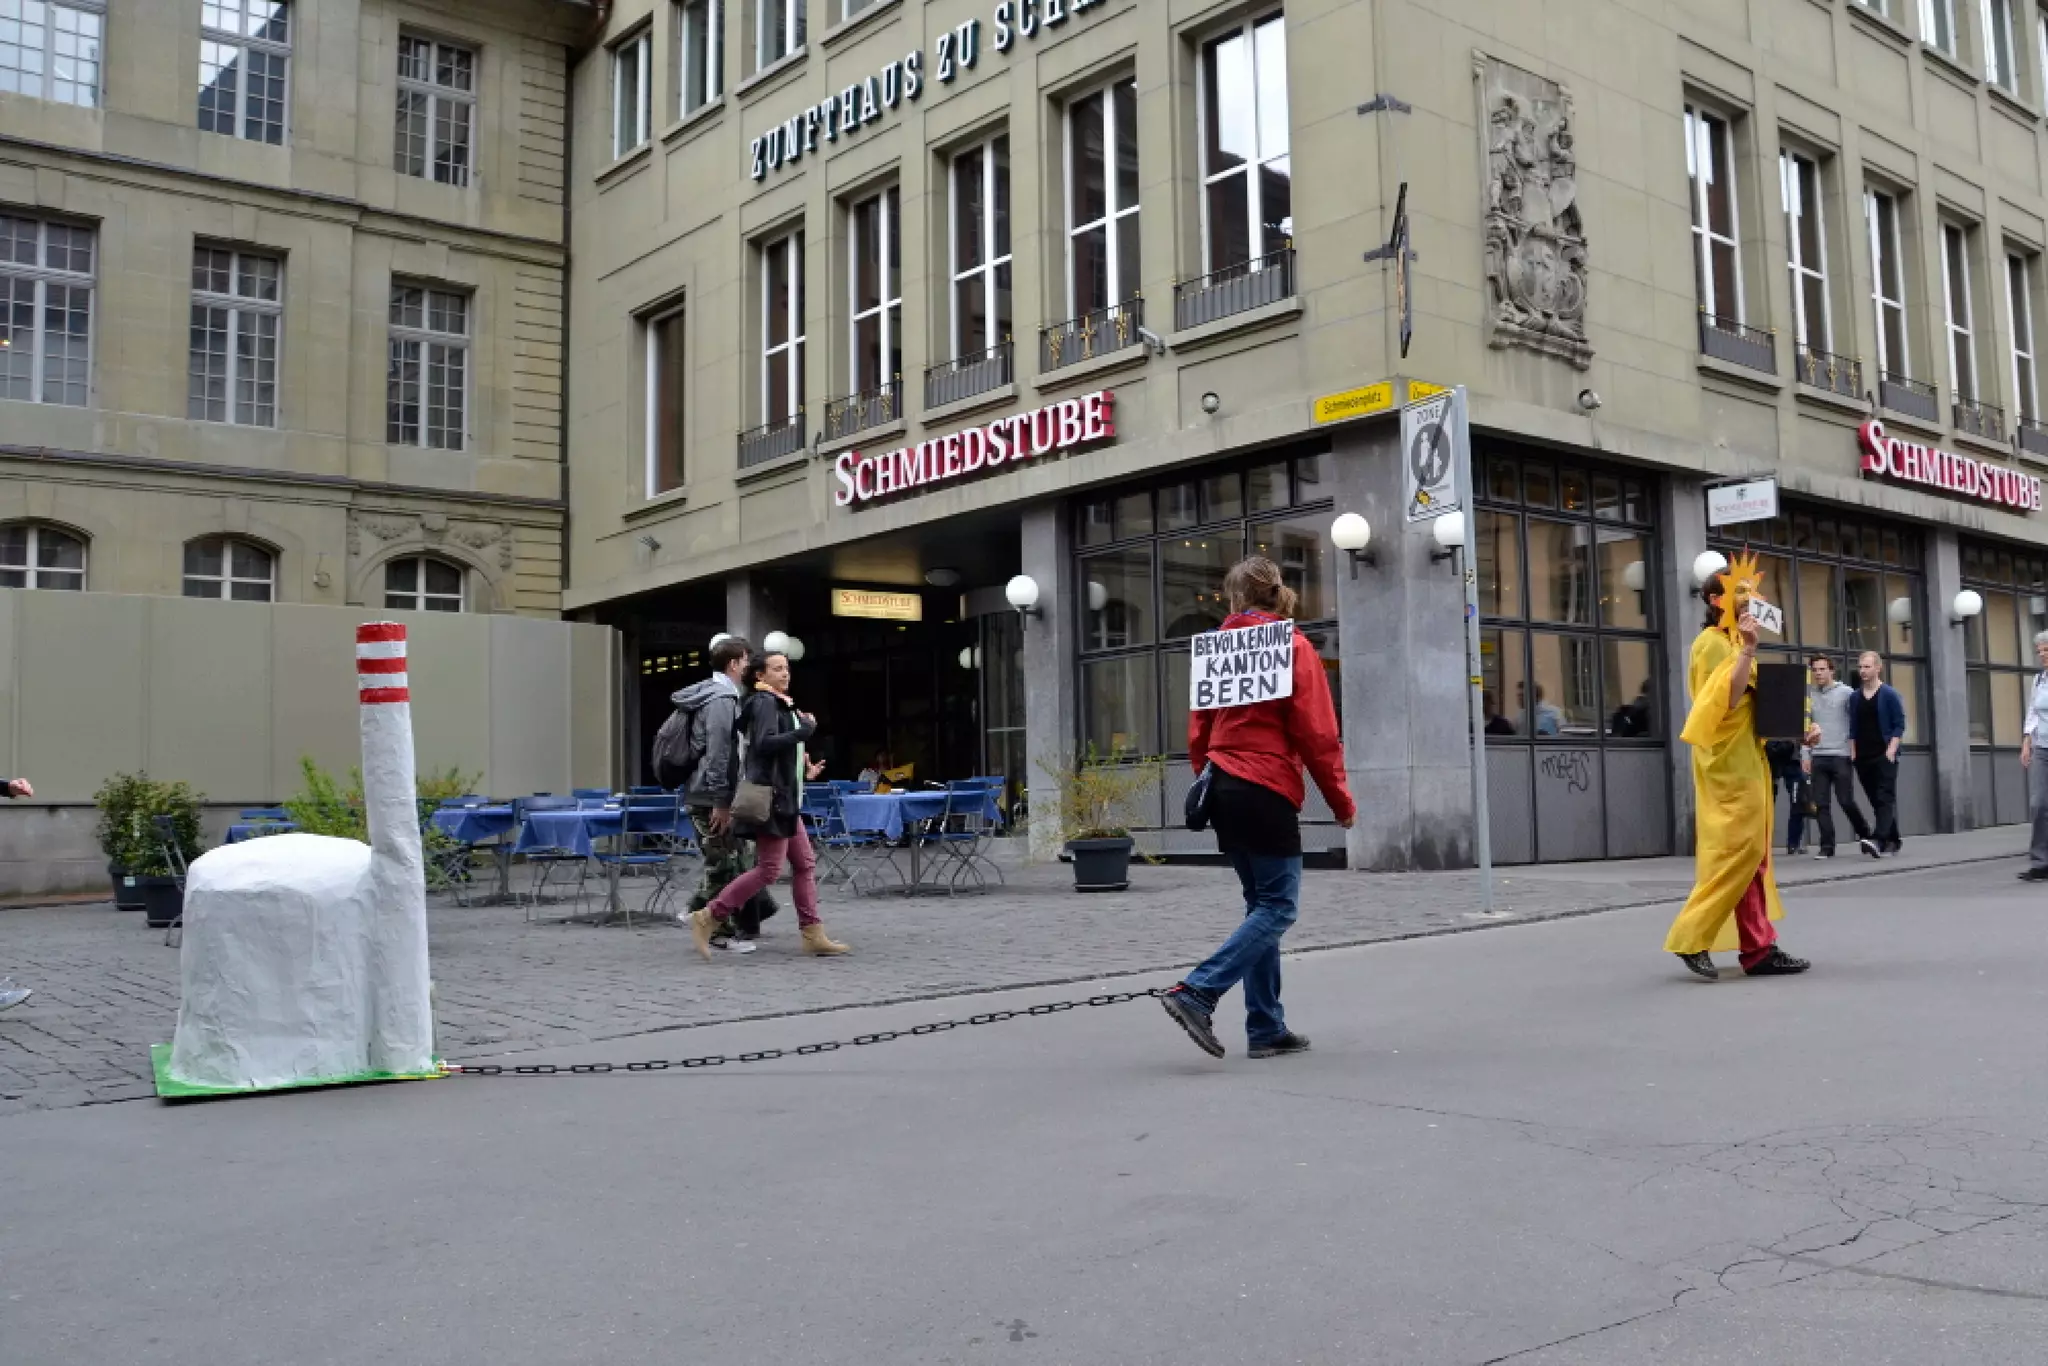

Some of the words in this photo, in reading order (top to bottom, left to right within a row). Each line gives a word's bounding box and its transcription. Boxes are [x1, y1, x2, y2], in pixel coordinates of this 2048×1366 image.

[751, 50, 923, 181] ZUNFTHAUS
[935, 18, 979, 82] ZU
[994, 0, 1105, 50] SCH
[1416, 404, 1442, 425] ZONE
[835, 391, 1106, 506] SCHMIEDSTUBE
[1867, 419, 2043, 511] SCHMIEDSTUBE
[1752, 599, 1778, 629] JA
[1194, 622, 1292, 658] BEVÖLKERUNG
[1205, 646, 1290, 678] KANTON
[1197, 673, 1277, 707] BERN
